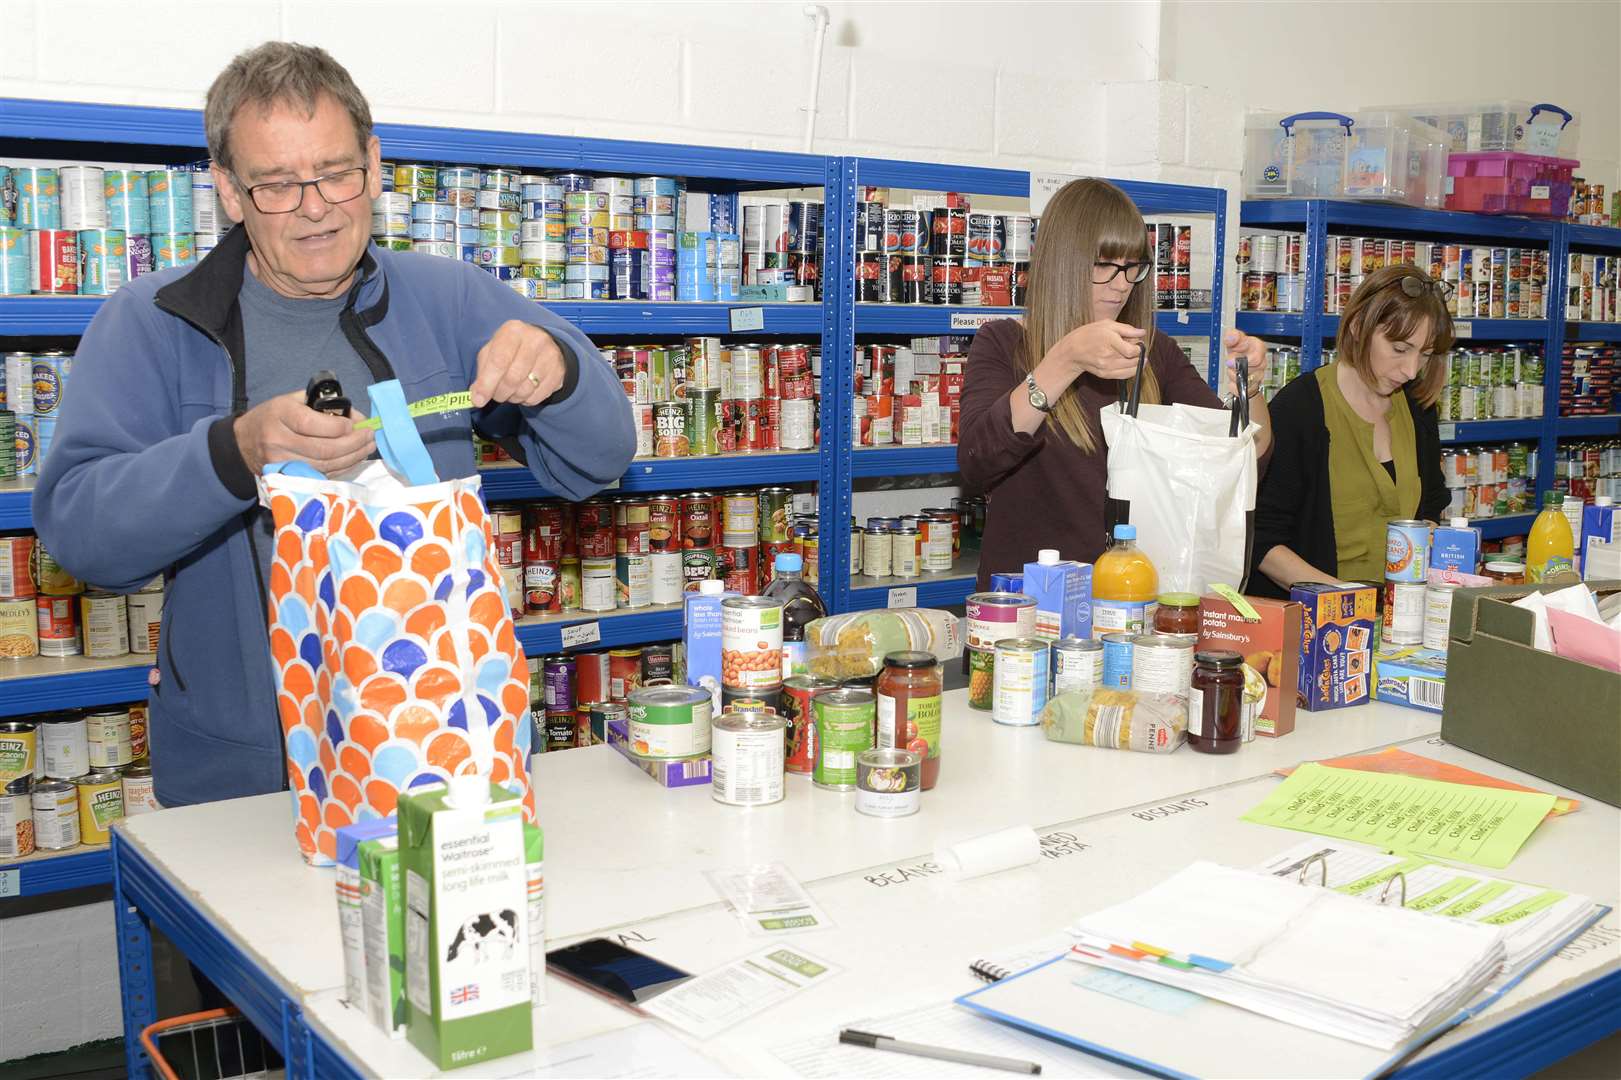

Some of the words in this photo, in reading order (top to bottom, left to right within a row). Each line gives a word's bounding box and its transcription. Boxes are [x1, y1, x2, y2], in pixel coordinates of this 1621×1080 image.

[952, 317, 975, 326] Please
[660, 407, 684, 416] HEINZ
[656, 416, 685, 429] BIG
[658, 429, 684, 437] SOUP
[650, 514, 667, 522] Lentil
[1440, 552, 1465, 560] BRITISH
[527, 567, 550, 576] HEINZ
[683, 566, 712, 577] BEEF
[1203, 609, 1227, 619] instant
[1203, 619, 1227, 628] potato
[1203, 630, 1212, 639] by
[1211, 630, 1251, 643] Sainsbury's
[1148, 722, 1156, 751] PENNE
[1131, 797, 1209, 822] BISCUITS
[440, 831, 489, 851] essential
[440, 846, 490, 862] Waitrose
[442, 856, 520, 879] semi-skimmed
[863, 861, 943, 888] BEANS
[441, 879, 468, 893] long
[469, 875, 485, 887] life
[486, 871, 509, 884] milk
